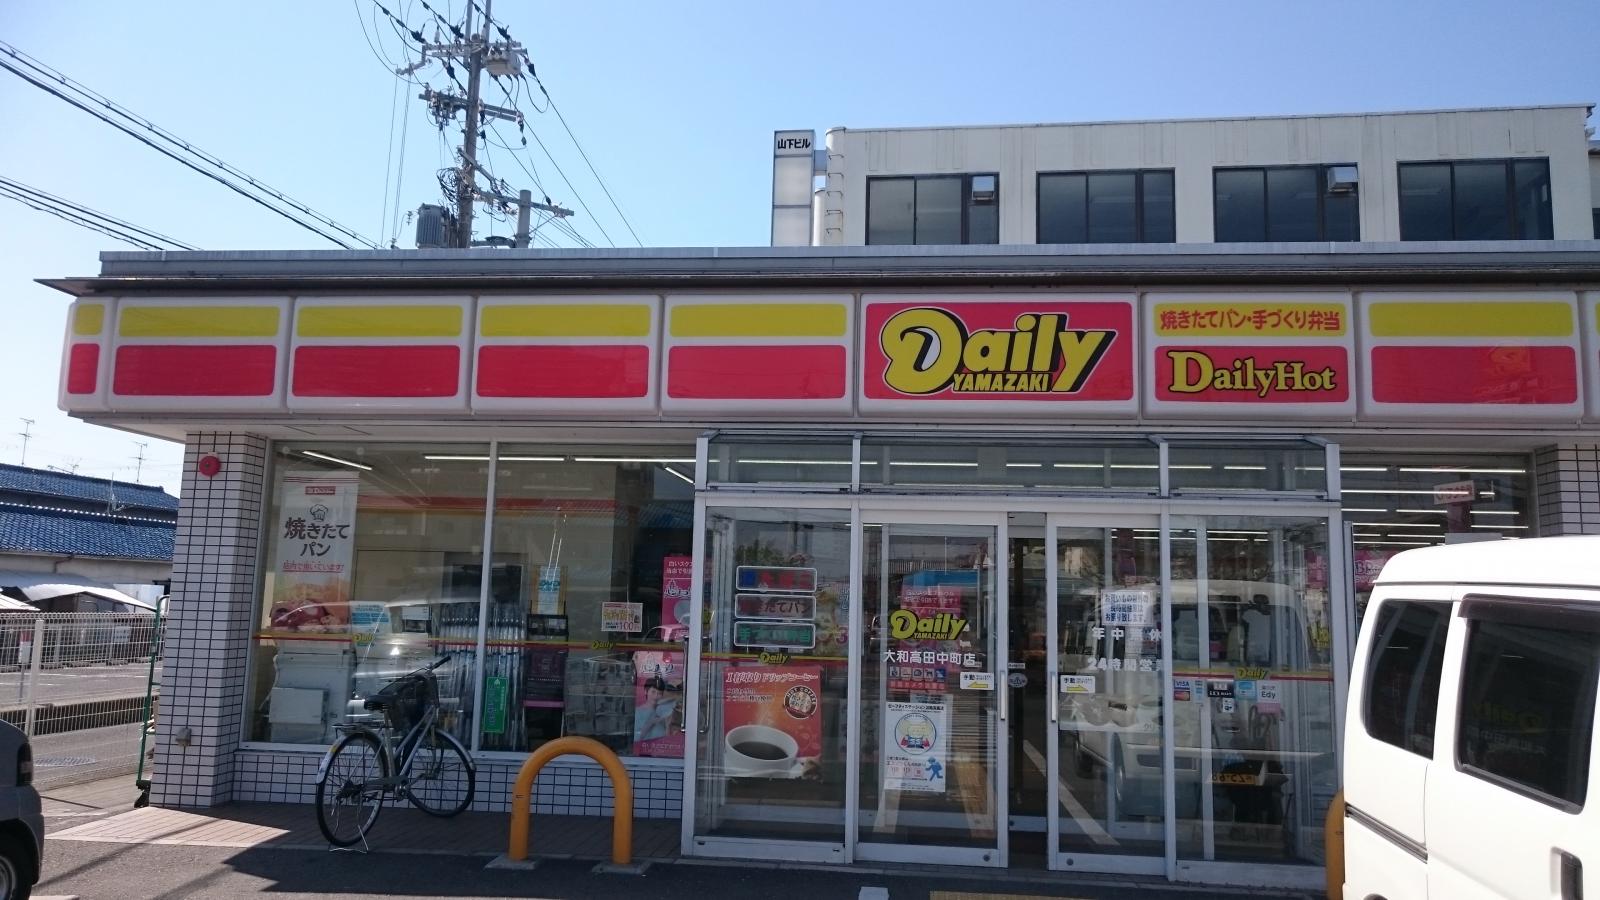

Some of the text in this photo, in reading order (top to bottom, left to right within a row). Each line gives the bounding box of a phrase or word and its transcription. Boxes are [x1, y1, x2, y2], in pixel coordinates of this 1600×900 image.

[778, 138, 810, 149] 山下ビル
[1160, 309, 1340, 331] 焼きたてパン・手づくり弁当
[880, 307, 1118, 396] Daily
[1168, 350, 1336, 399] DailyHot
[951, 373, 1051, 393] YAMAZAKI
[284, 517, 350, 540] 焼きたて
[300, 541, 331, 557] パン
[890, 609, 968, 640] Daily
[914, 632, 947, 640] YAMAZAKI
[759, 652, 790, 664] Daily
[883, 650, 976, 666] 大和高田中町店
[1237, 667, 1268, 679] Daily
[1175, 680, 1190, 688] VISA
[1261, 691, 1276, 700] Edy
